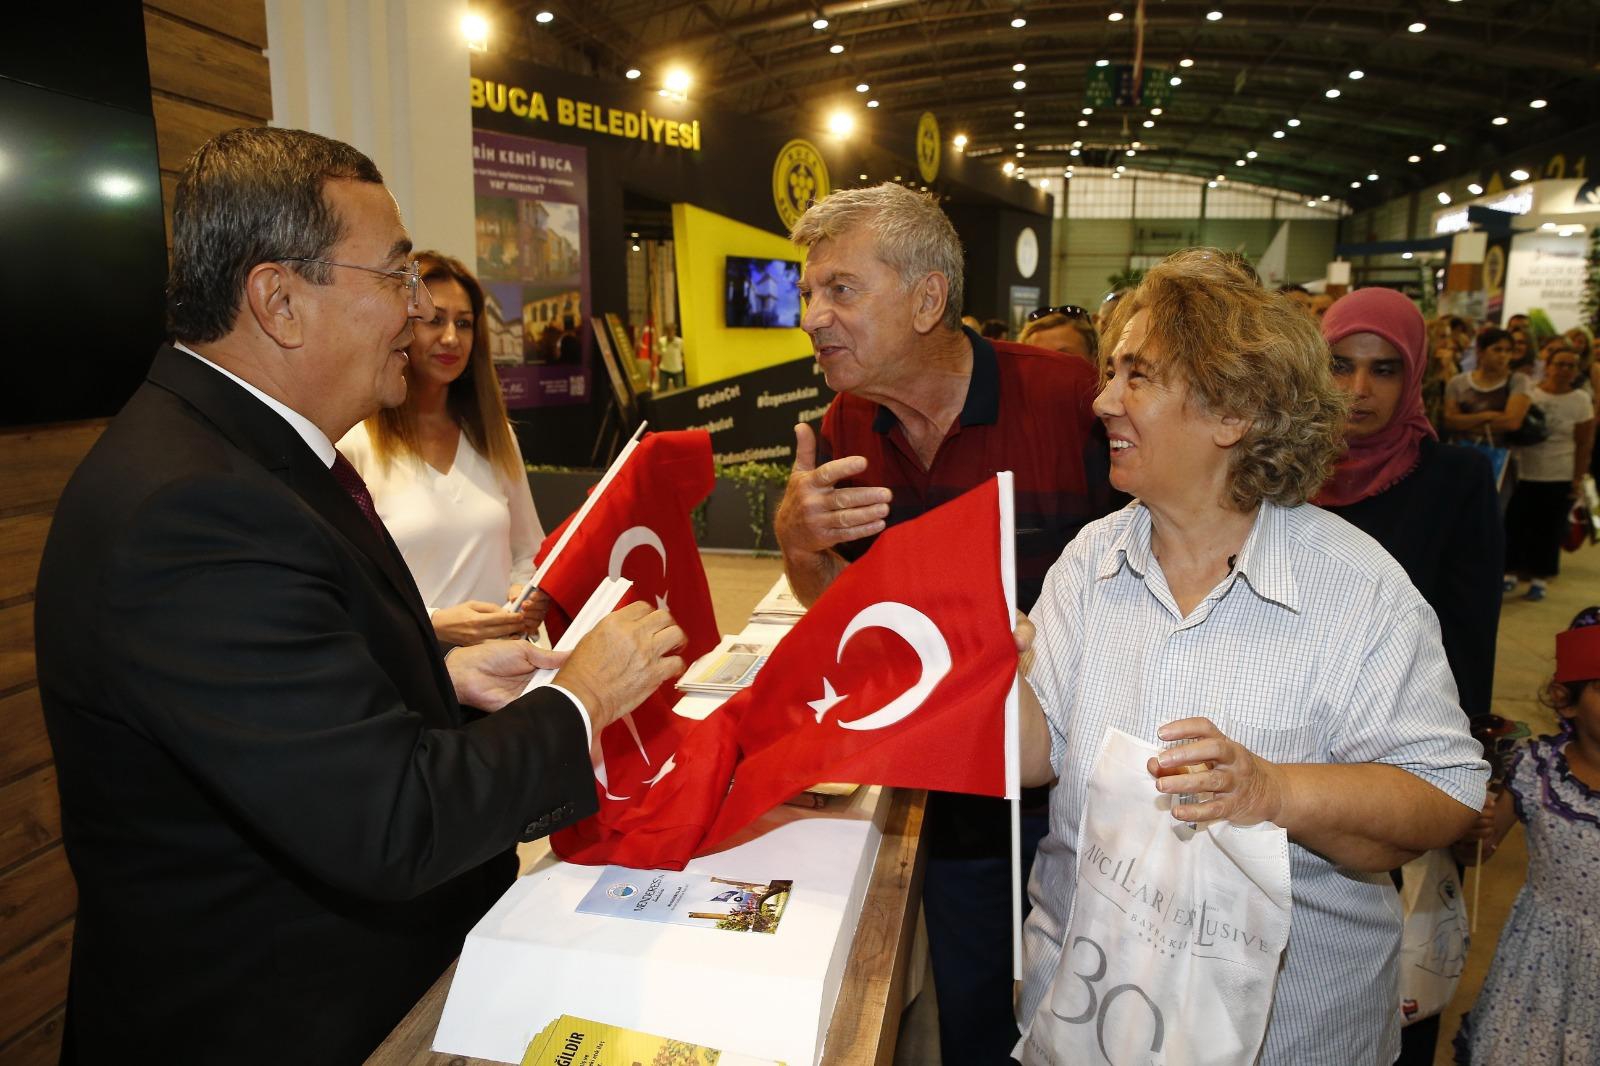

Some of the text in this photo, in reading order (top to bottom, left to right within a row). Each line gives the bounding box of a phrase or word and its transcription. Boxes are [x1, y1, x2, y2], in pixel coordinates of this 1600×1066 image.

[471, 77, 701, 151] BUCA BELEDİYESİ
[499, 150, 536, 167] KENTİ
[540, 155, 573, 172] BUCA
